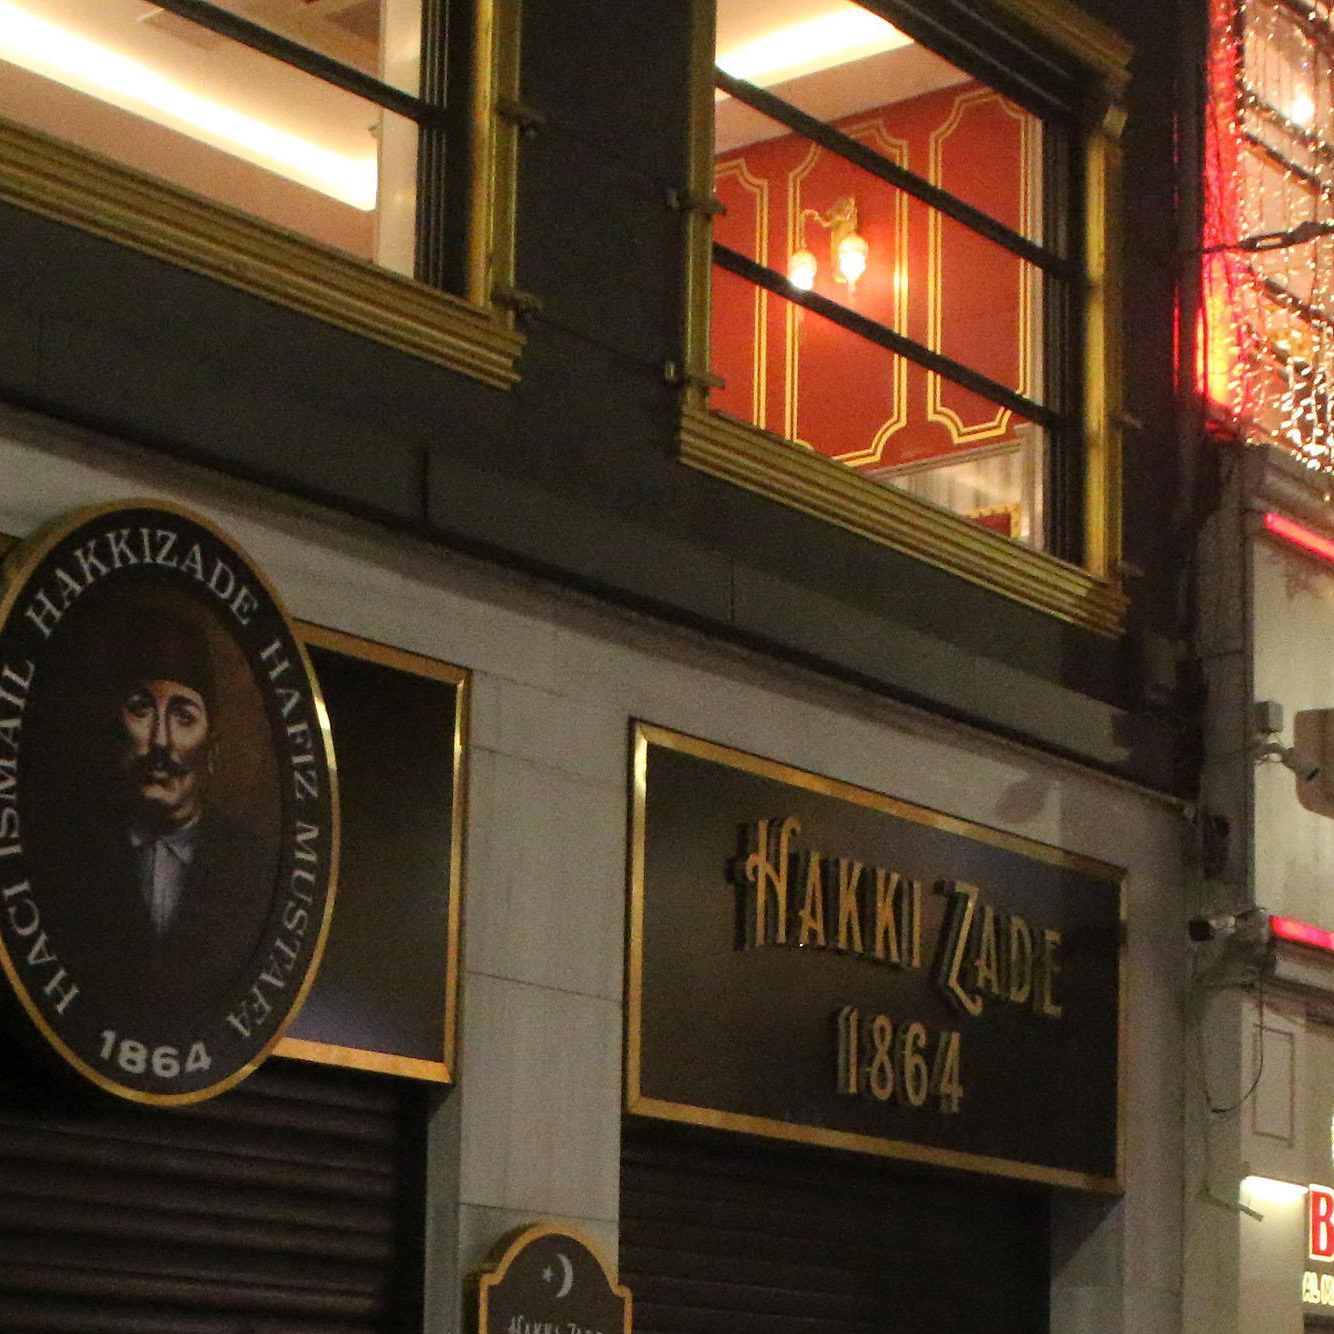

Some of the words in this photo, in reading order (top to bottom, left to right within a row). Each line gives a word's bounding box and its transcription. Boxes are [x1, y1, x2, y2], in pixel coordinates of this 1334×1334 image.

[25, 527, 260, 640] HAKKIZADE
[260, 638, 319, 802] HAFIZ
[3, 881, 80, 1015] HACI
[224, 820, 320, 1039] MUSTAFA
[745, 816, 922, 970] HAKKI
[943, 879, 1064, 1019] ZADE
[99, 1029, 213, 1079] 1864
[842, 1004, 964, 1115] 1864
